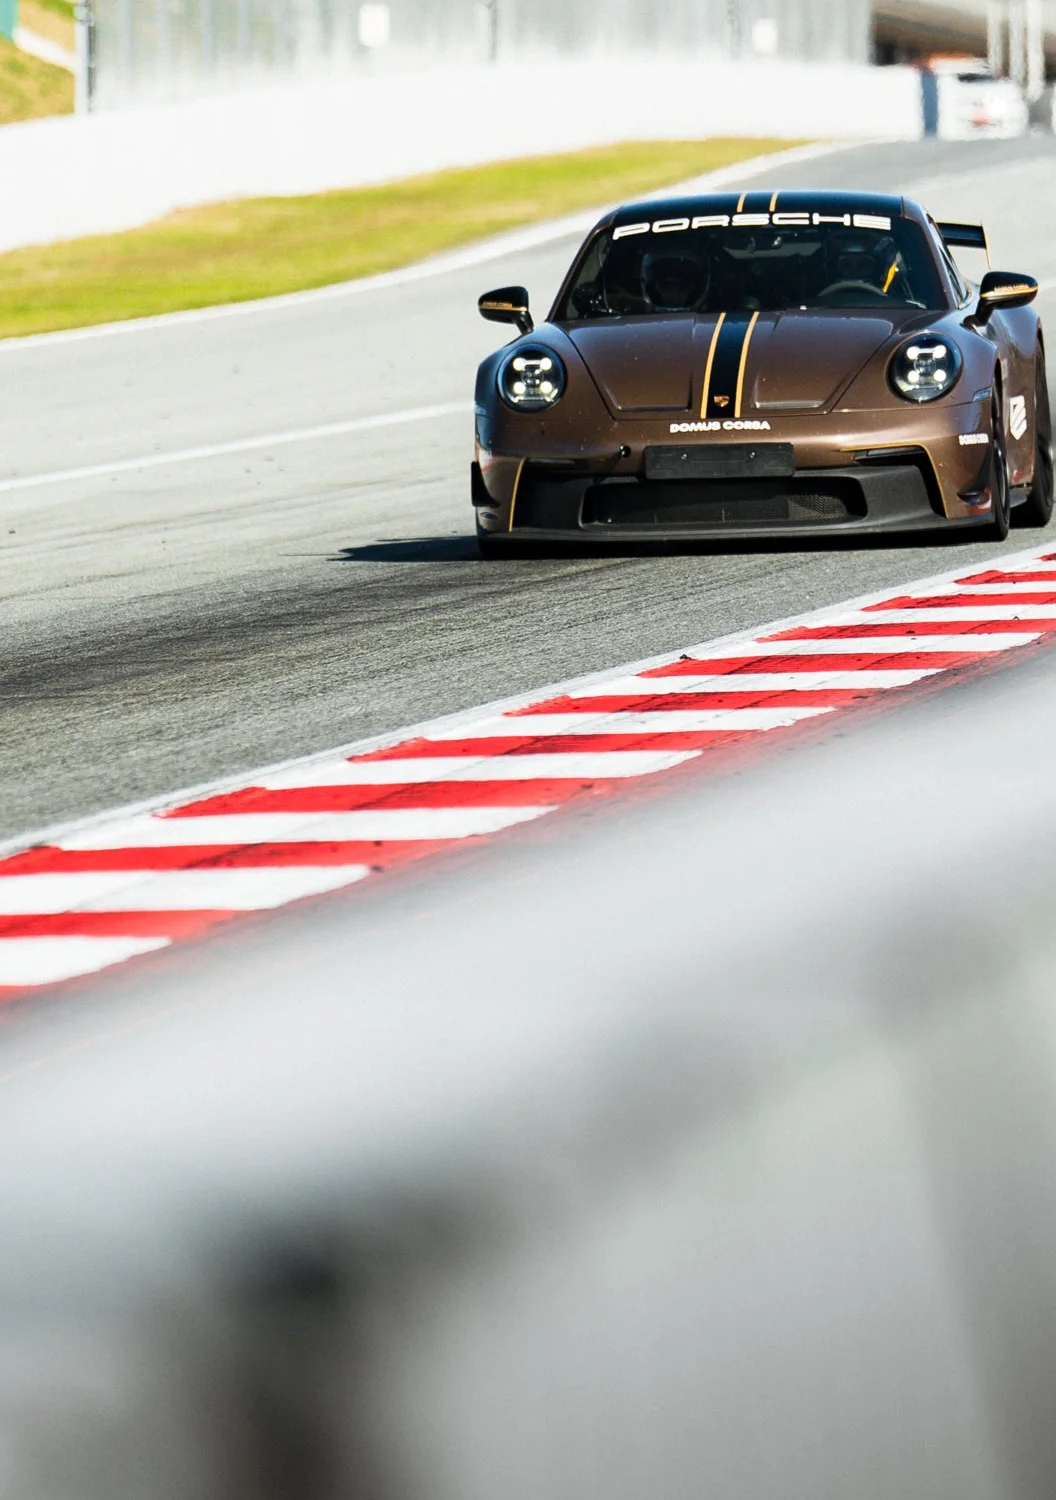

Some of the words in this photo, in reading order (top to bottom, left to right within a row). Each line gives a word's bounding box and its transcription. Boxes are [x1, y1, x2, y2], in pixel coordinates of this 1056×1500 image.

[612, 212, 891, 240] PORSCHE
[670, 421, 721, 433] DOMUS
[723, 420, 771, 431] CORSA
